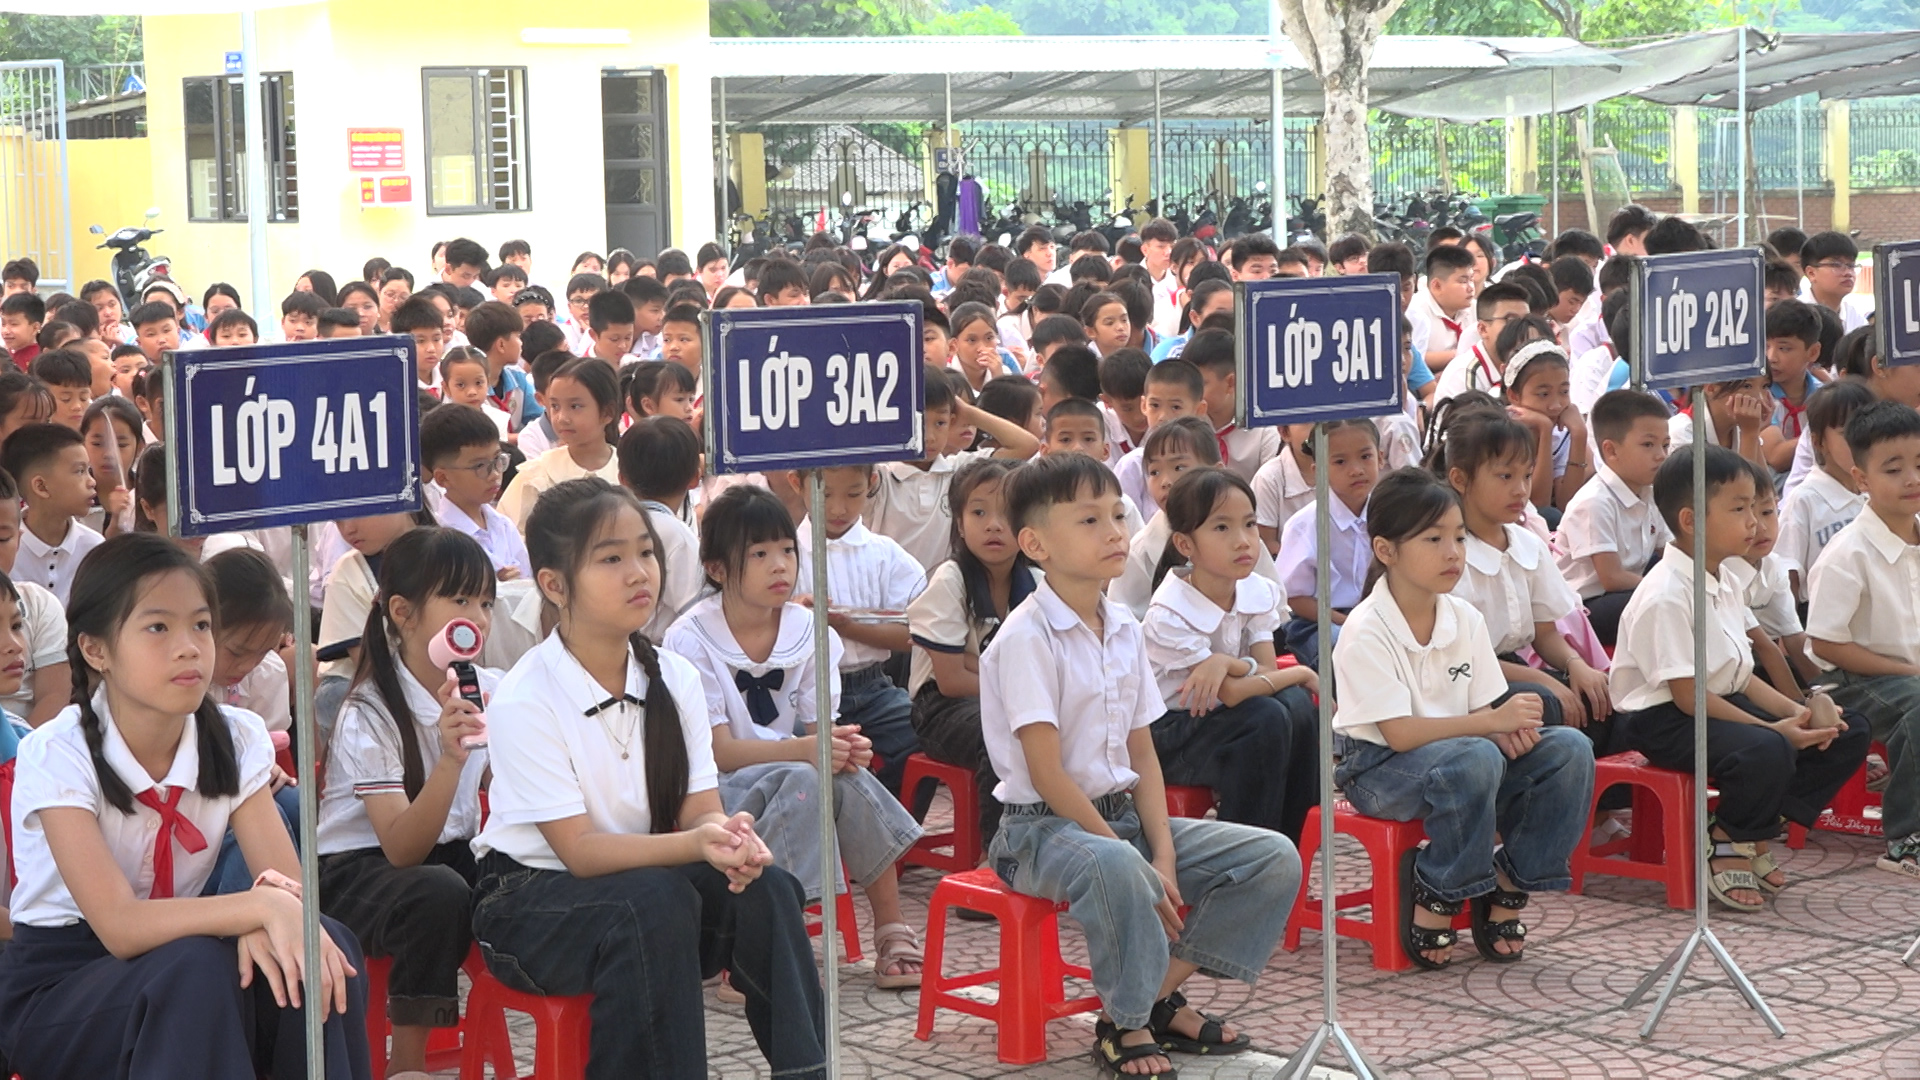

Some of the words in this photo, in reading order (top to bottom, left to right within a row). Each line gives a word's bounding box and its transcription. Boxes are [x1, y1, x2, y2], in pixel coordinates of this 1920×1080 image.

[1267, 302, 1323, 389] LỚP
[1331, 317, 1383, 384] 3A1
[1655, 275, 1698, 354] LỚP
[1705, 287, 1749, 348] 2A2
[738, 335, 813, 432] LỚP
[826, 351, 899, 426] 3A2
[210, 375, 296, 486] LỚP
[311, 390, 389, 475] 4A1
